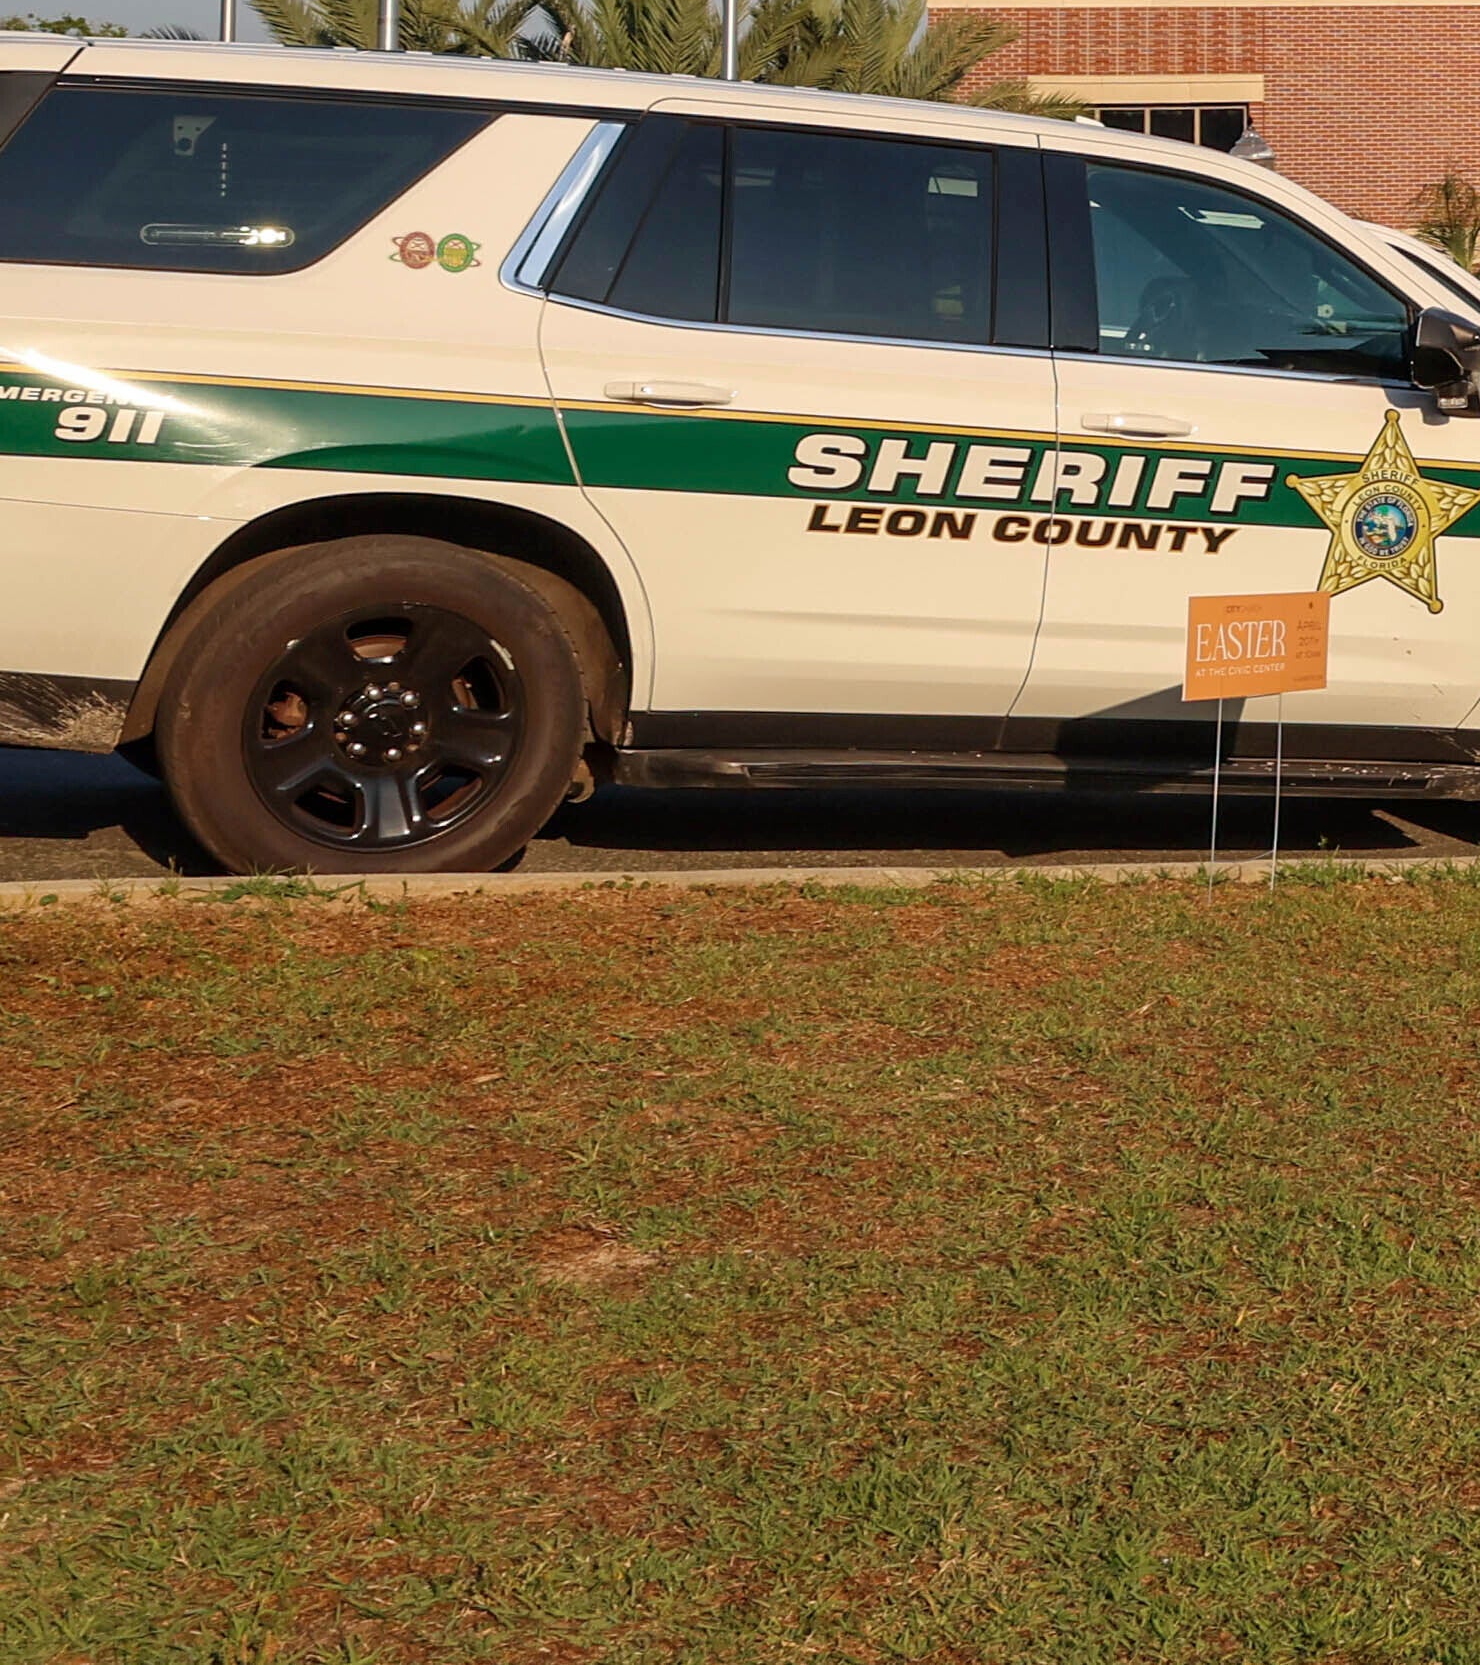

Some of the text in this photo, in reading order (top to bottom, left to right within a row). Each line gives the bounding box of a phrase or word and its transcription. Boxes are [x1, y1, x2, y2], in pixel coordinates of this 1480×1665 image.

[54, 405, 165, 445] 911
[787, 433, 1276, 514] SHERIFF
[1362, 470, 1420, 486] SHERIFF
[1353, 484, 1424, 511] LEON COUNTY
[807, 504, 1240, 553] LEON COUNTY
[1357, 555, 1408, 569] FLORIDA
[1196, 619, 1287, 662] EASTER
[1196, 663, 1285, 677] AT THE CIVIC CENTER
